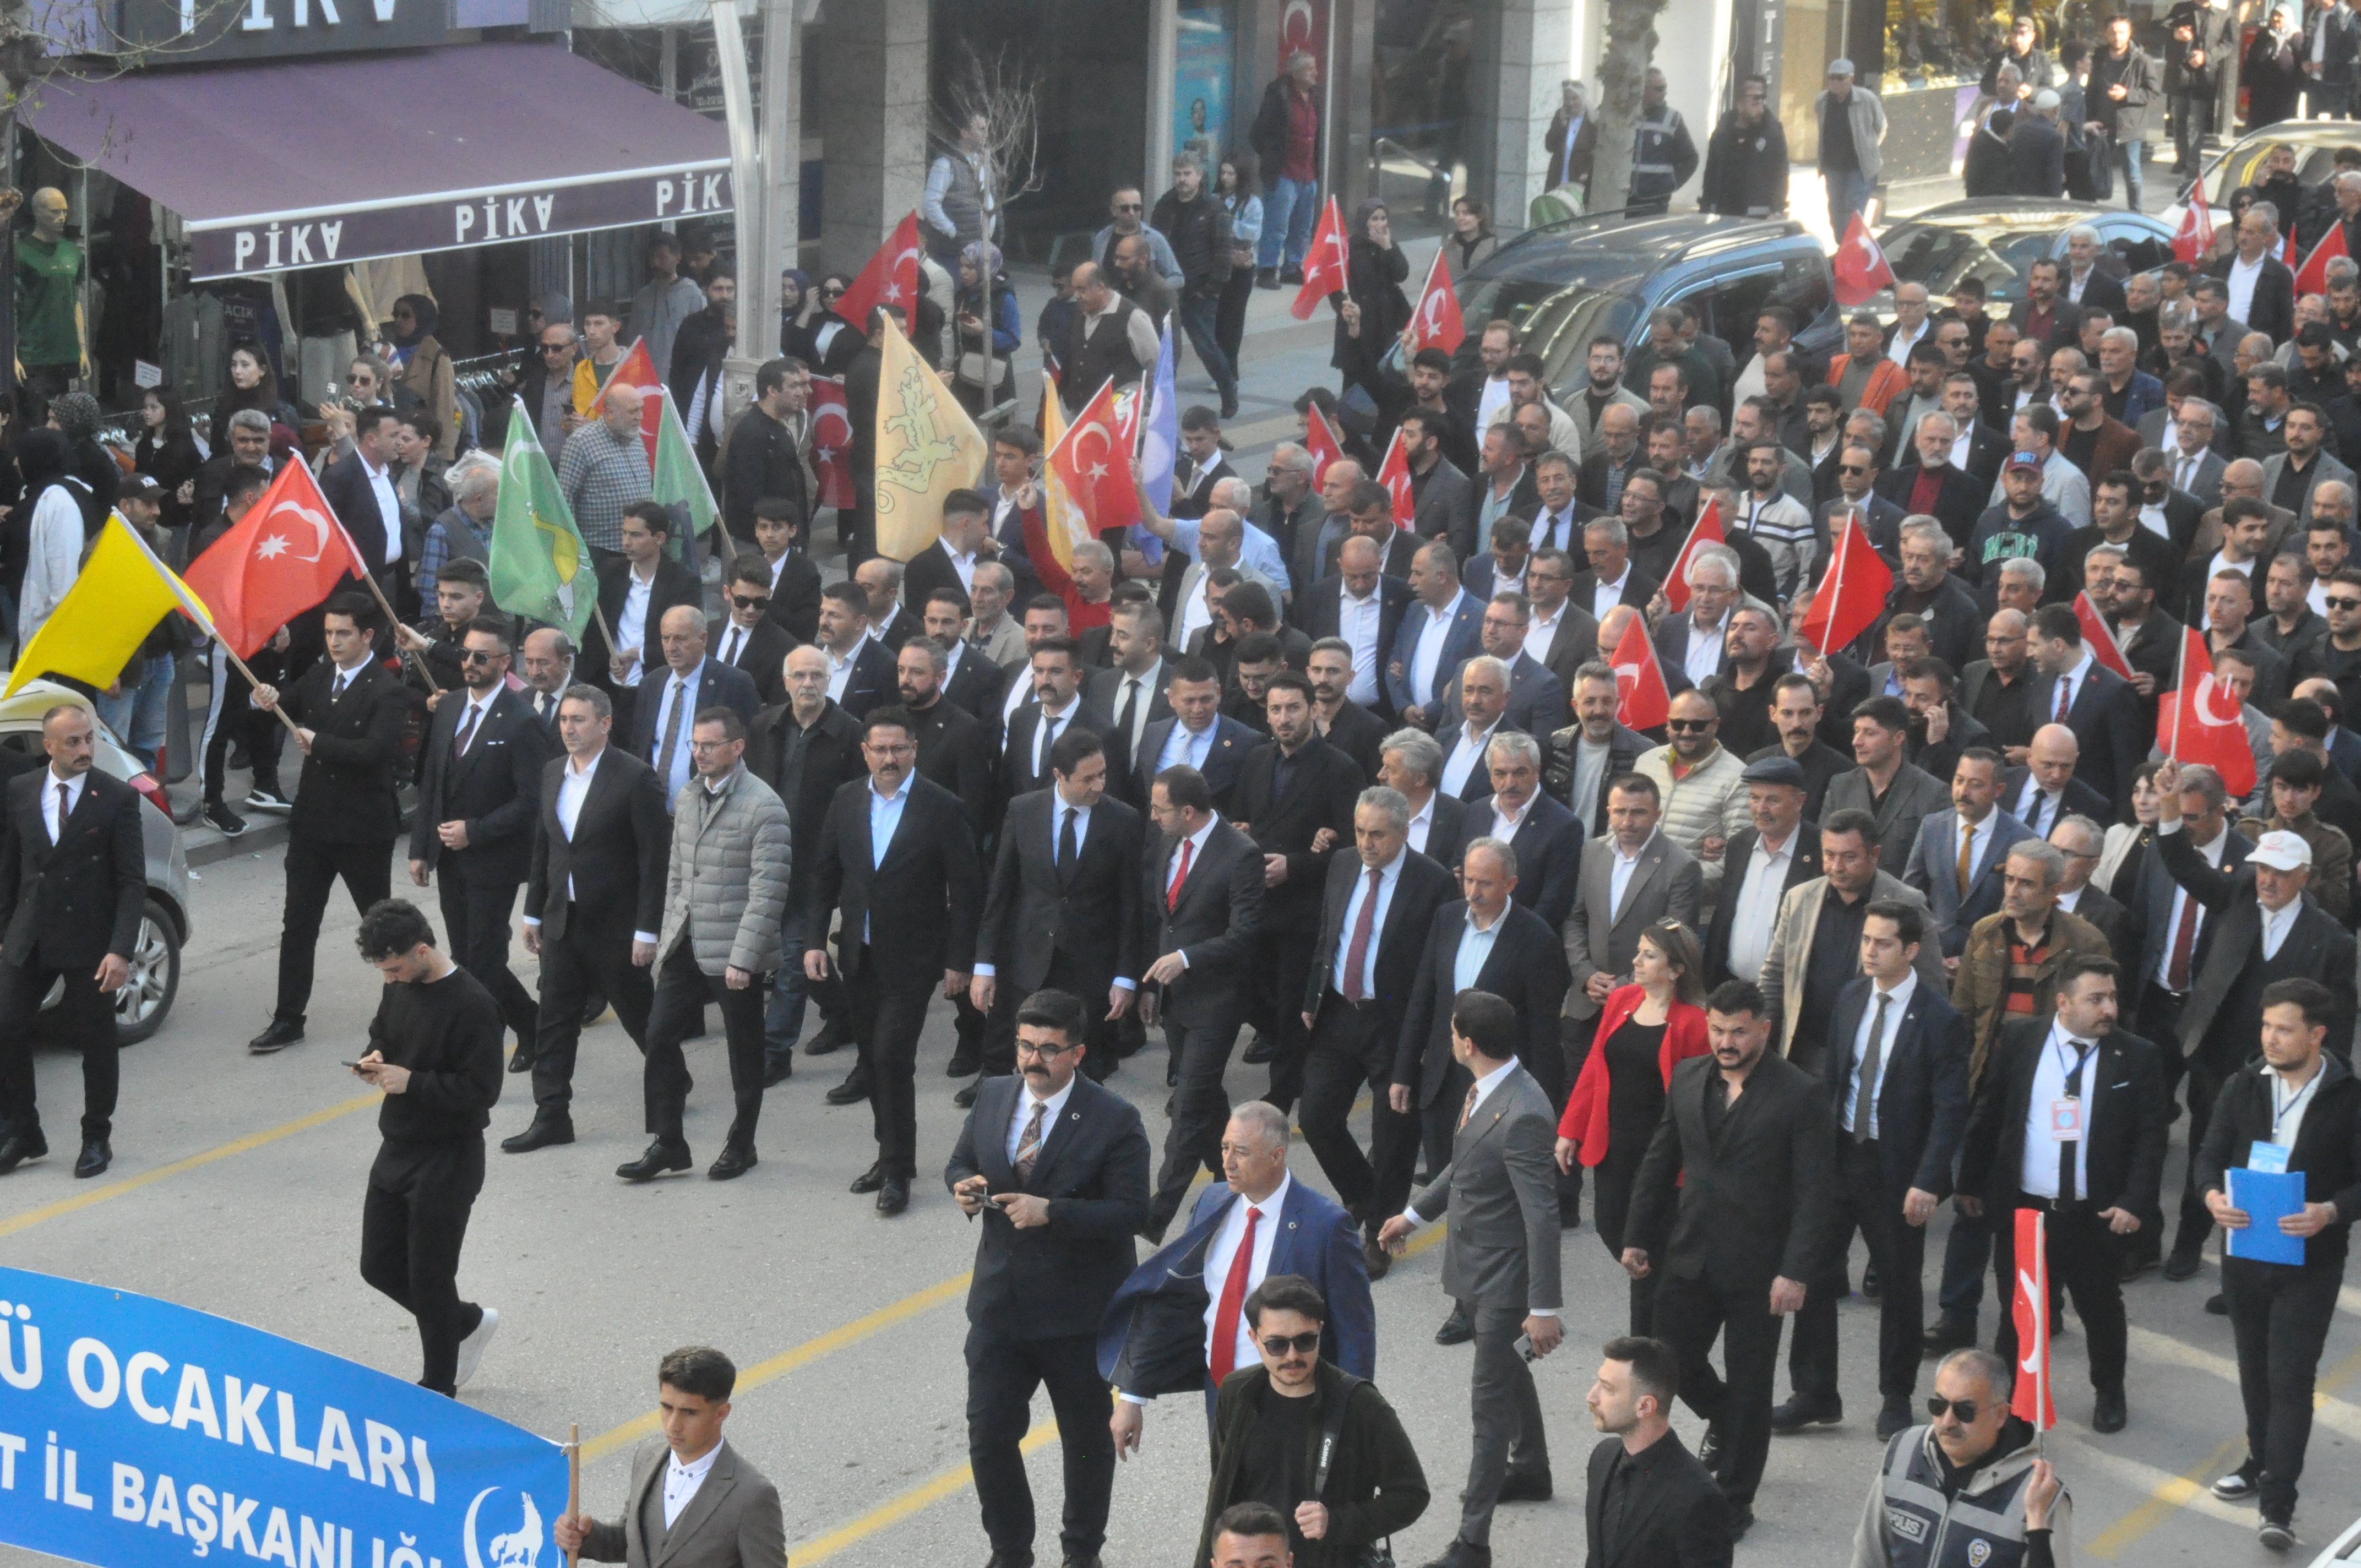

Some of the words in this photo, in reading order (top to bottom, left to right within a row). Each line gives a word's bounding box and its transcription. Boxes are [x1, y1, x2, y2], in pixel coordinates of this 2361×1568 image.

[657, 166, 735, 216] PİK
[68, 1337, 435, 1505] OCAKLARI
[1321, 1438, 1331, 1467] Canon
[45, 1430, 93, 1510] İL
[112, 1461, 442, 1568] BAŞKANLIĞ
